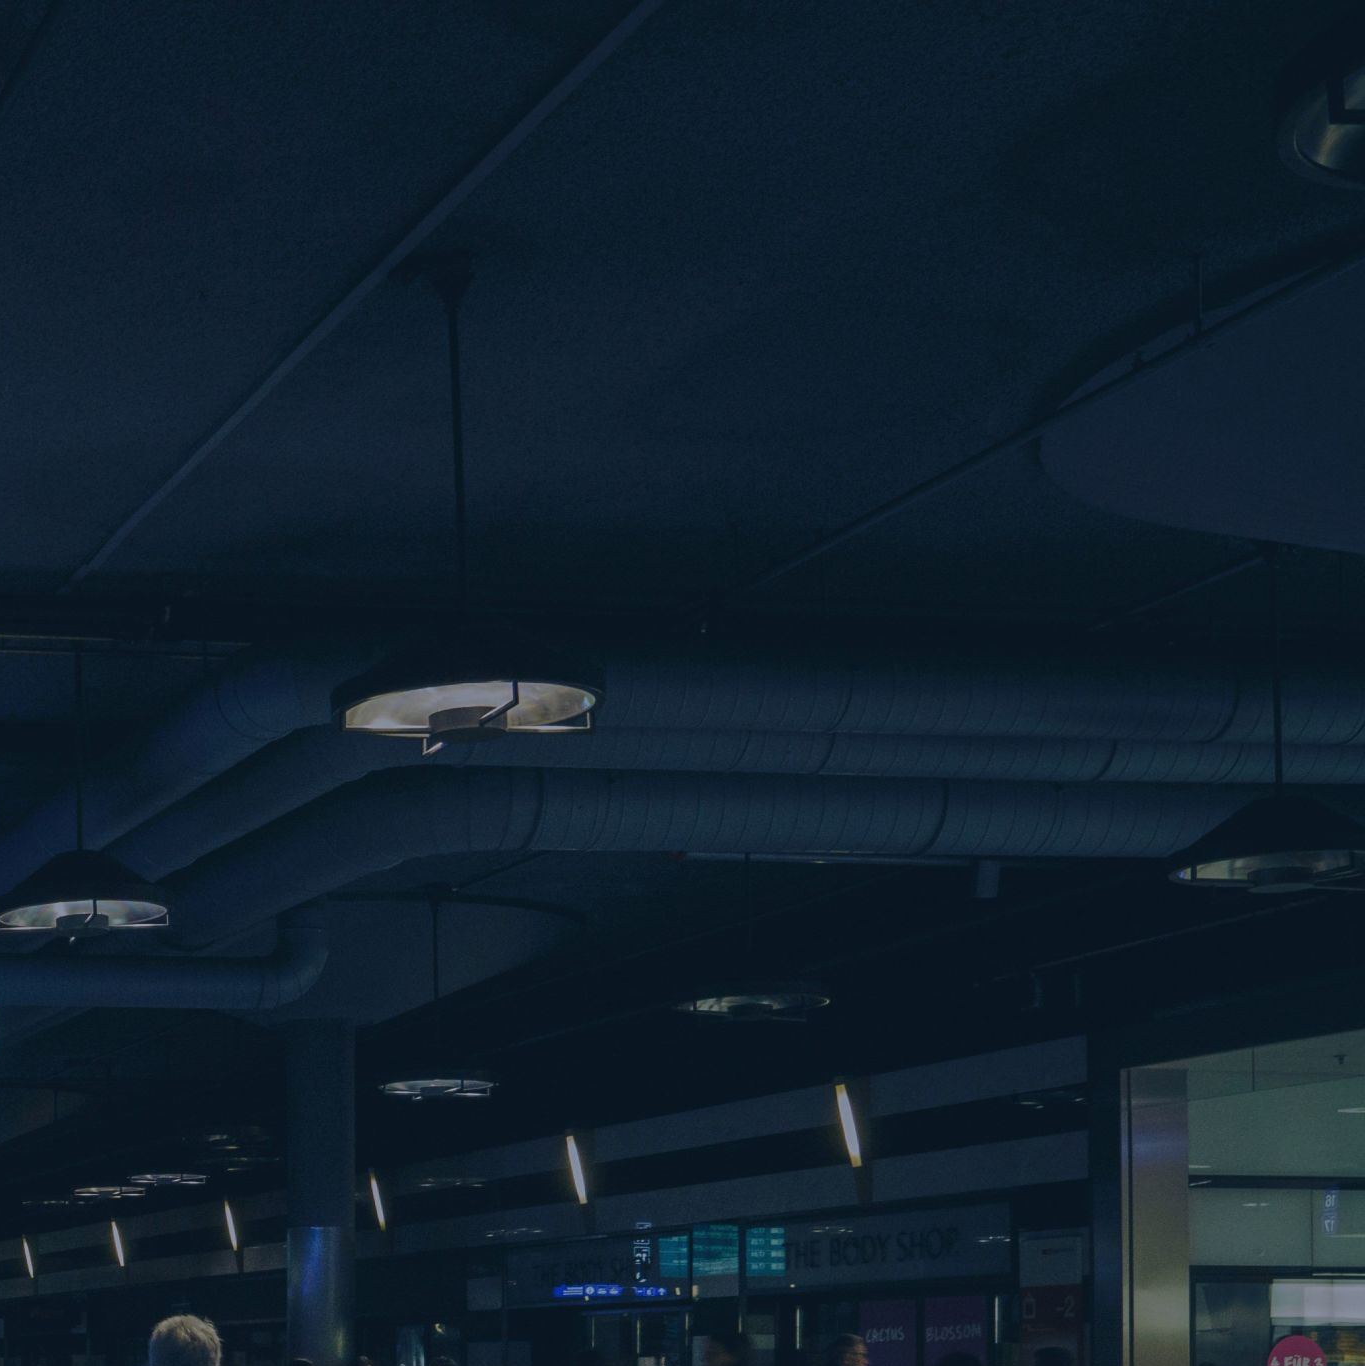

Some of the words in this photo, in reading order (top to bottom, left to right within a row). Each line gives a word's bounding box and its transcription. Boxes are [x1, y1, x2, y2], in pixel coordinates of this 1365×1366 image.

[788, 1238, 823, 1269] THE
[829, 1233, 891, 1268] BODY
[896, 1226, 961, 1264] SHOP
[866, 1326, 906, 1343] CACTUS
[925, 1322, 982, 1343] BLOSSOM
